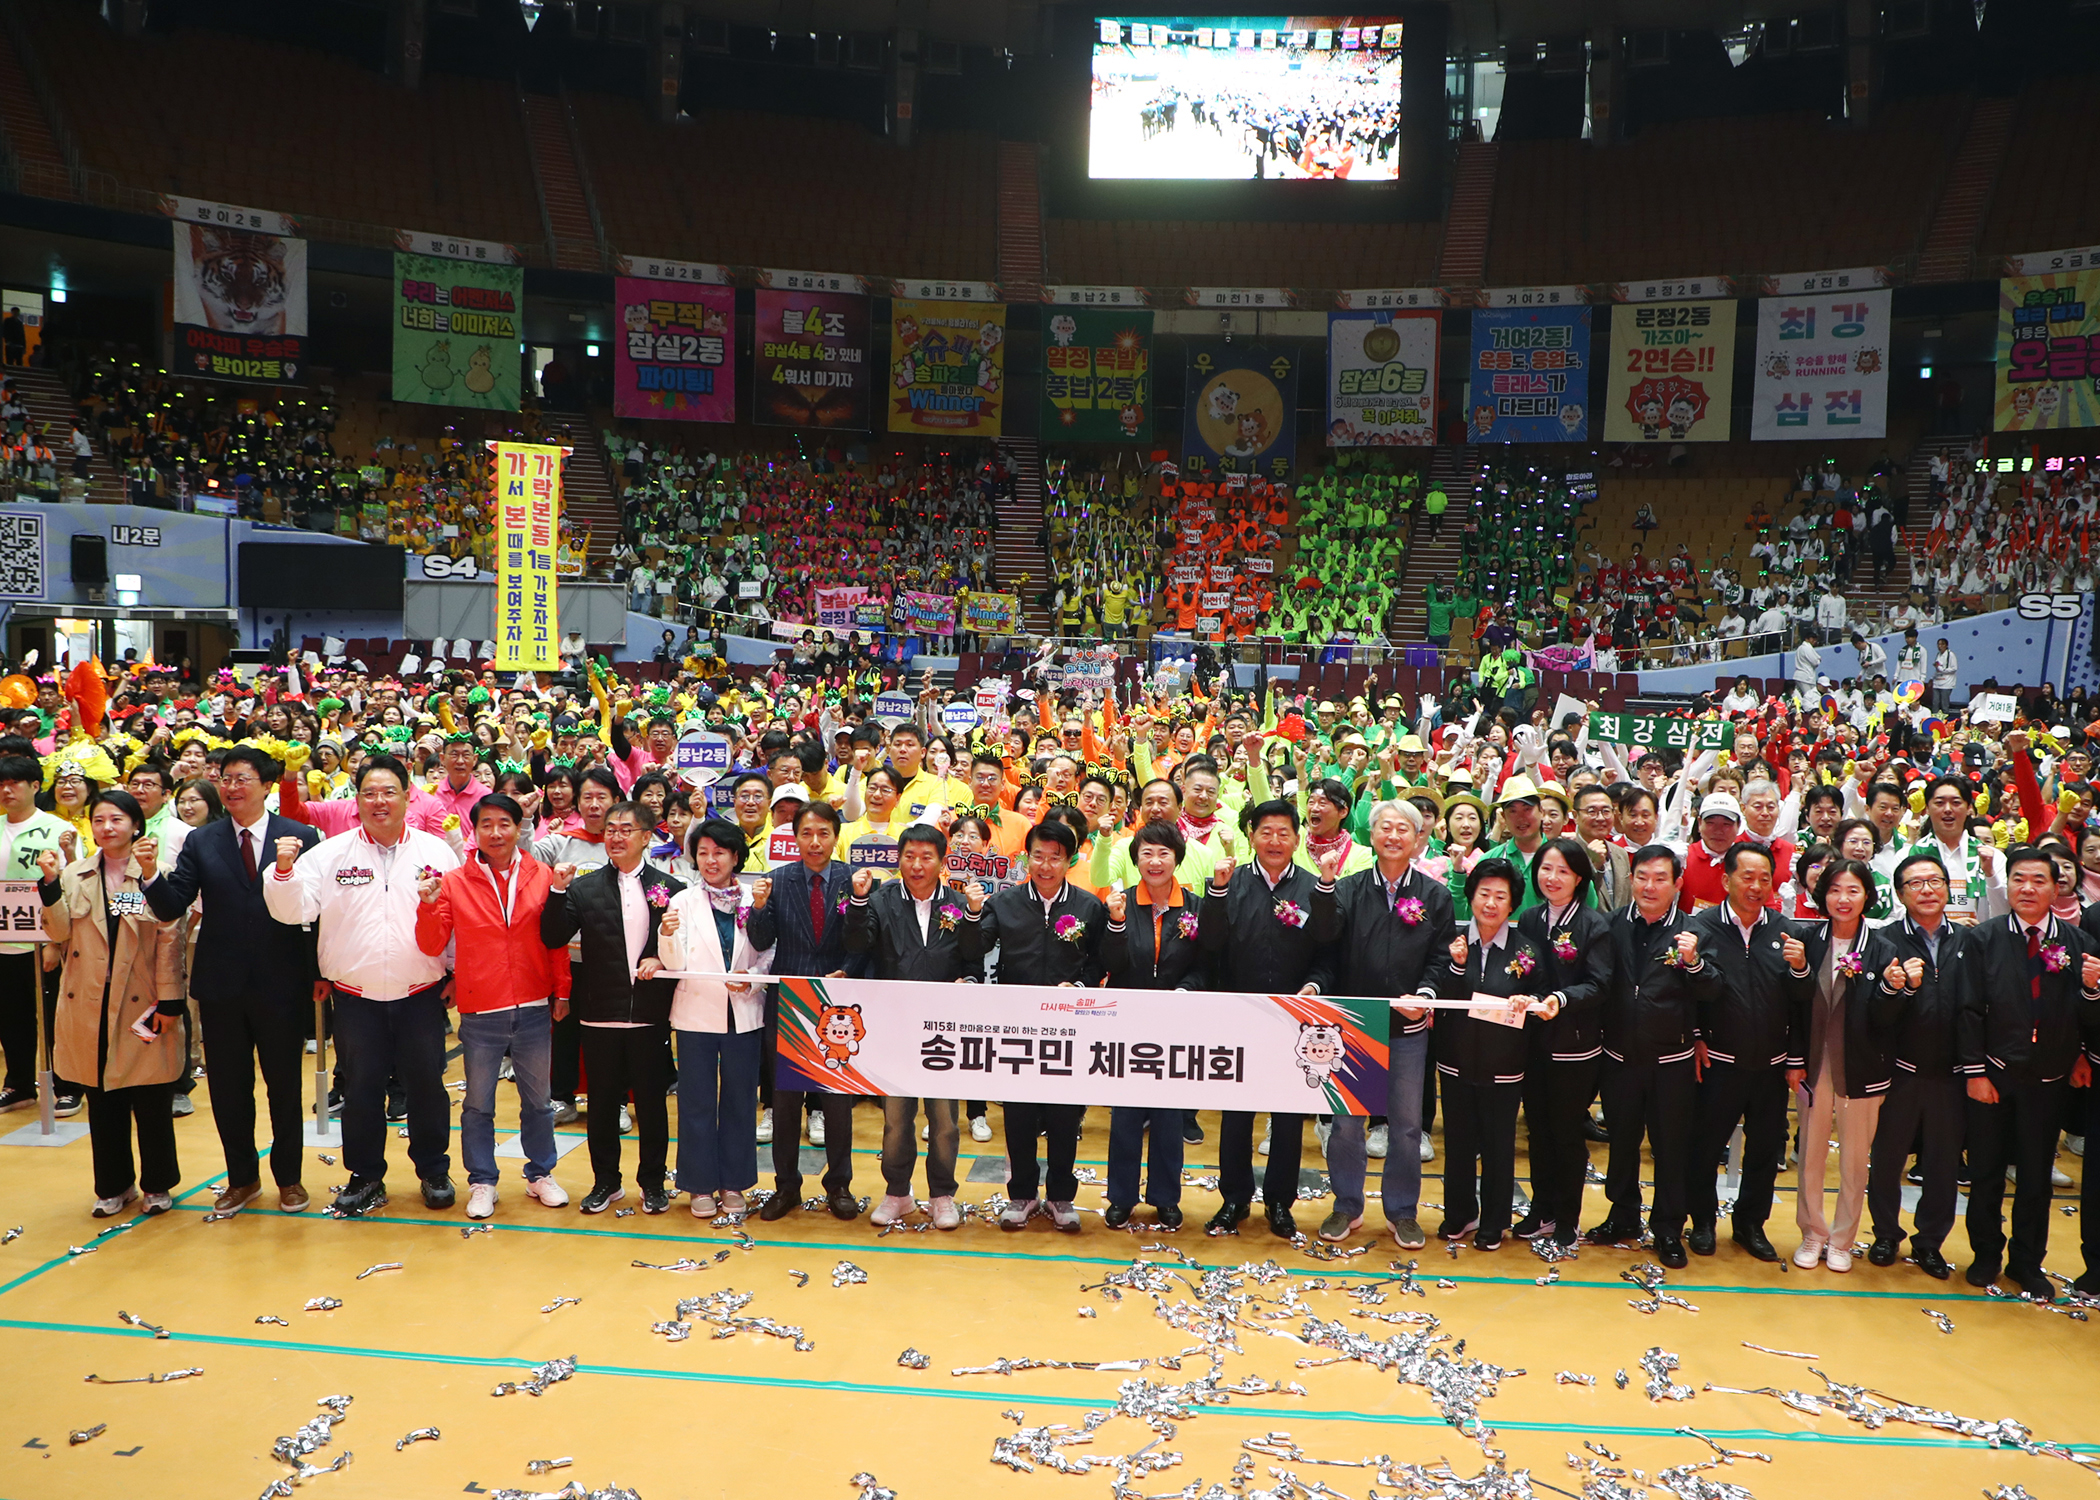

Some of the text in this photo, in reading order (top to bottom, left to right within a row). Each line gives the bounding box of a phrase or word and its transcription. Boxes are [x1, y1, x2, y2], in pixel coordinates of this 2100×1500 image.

[198, 206, 263, 228] 방이2동
[431, 240, 486, 259] 방이1동
[649, 264, 702, 280] 잠실2동
[1804, 275, 1850, 290] 삼전동
[788, 276, 839, 290] 잠실4동
[921, 286, 972, 297] 송파2동
[1646, 283, 1701, 298] 문정2동
[402, 279, 516, 313] 우리는 어벤져스
[1216, 293, 1265, 304] 마천1동
[1367, 294, 1418, 306] 잠실6동
[1507, 292, 1560, 305] 거여2동
[2024, 286, 2075, 308] 우승기
[402, 305, 449, 332] 너희는
[649, 299, 704, 332] 무적
[783, 306, 845, 337] 불4조
[1636, 306, 1711, 328] 문정2동
[187, 328, 300, 358] 어차피 우승은
[1490, 325, 1573, 349] 거여2동!
[1641, 329, 1703, 345] 가즈아~
[2013, 325, 2047, 340] 1등은
[627, 331, 725, 366] 잠실2동
[763, 341, 861, 363] 잠실4동 4라 있네
[1047, 346, 1148, 371] 열정 폭발!
[212, 355, 281, 379] 방이2동
[1479, 349, 1582, 371] 운동도, 응원도,
[1627, 346, 1715, 373] 2연승!!
[1796, 353, 1847, 367] 우승을 향해
[637, 365, 714, 395] 파이팅!
[772, 364, 853, 388] 4워서 이기자
[914, 364, 978, 385] 송파2동
[1340, 361, 1427, 394] 잠실6동
[1795, 366, 1846, 377] RUNNING
[1492, 373, 1567, 394] 클래스가
[908, 388, 985, 412] Winner
[1498, 396, 1558, 417] 다르다!
[1362, 408, 1376, 423] 꼭
[504, 452, 528, 496] 가서
[531, 454, 555, 548] 가락본동
[112, 525, 160, 546] 내2문
[505, 505, 526, 568] 본때를
[424, 554, 479, 579] S4
[527, 549, 551, 570] 1등
[908, 604, 950, 621] Winner
[968, 605, 1010, 620] Winner
[2018, 593, 2084, 619] S5
[820, 610, 846, 625] 열정
[876, 702, 911, 714] 풍납2동
[944, 710, 975, 721] 풍납2동
[1988, 701, 2013, 713] 거여1동
[678, 749, 727, 763] 풍납2동
[851, 849, 899, 863] 풍납2동
[948, 855, 1009, 879] 마천1동
[113, 892, 144, 903] 구의원
[109, 903, 145, 916] 정주리
[1041, 1003, 1074, 1012] 다시 뛰는
[923, 1021, 1076, 1036] 제15회 한마음으로 같이 하는 건강 송파
[921, 1034, 1244, 1083] 송파구민 체육대회
